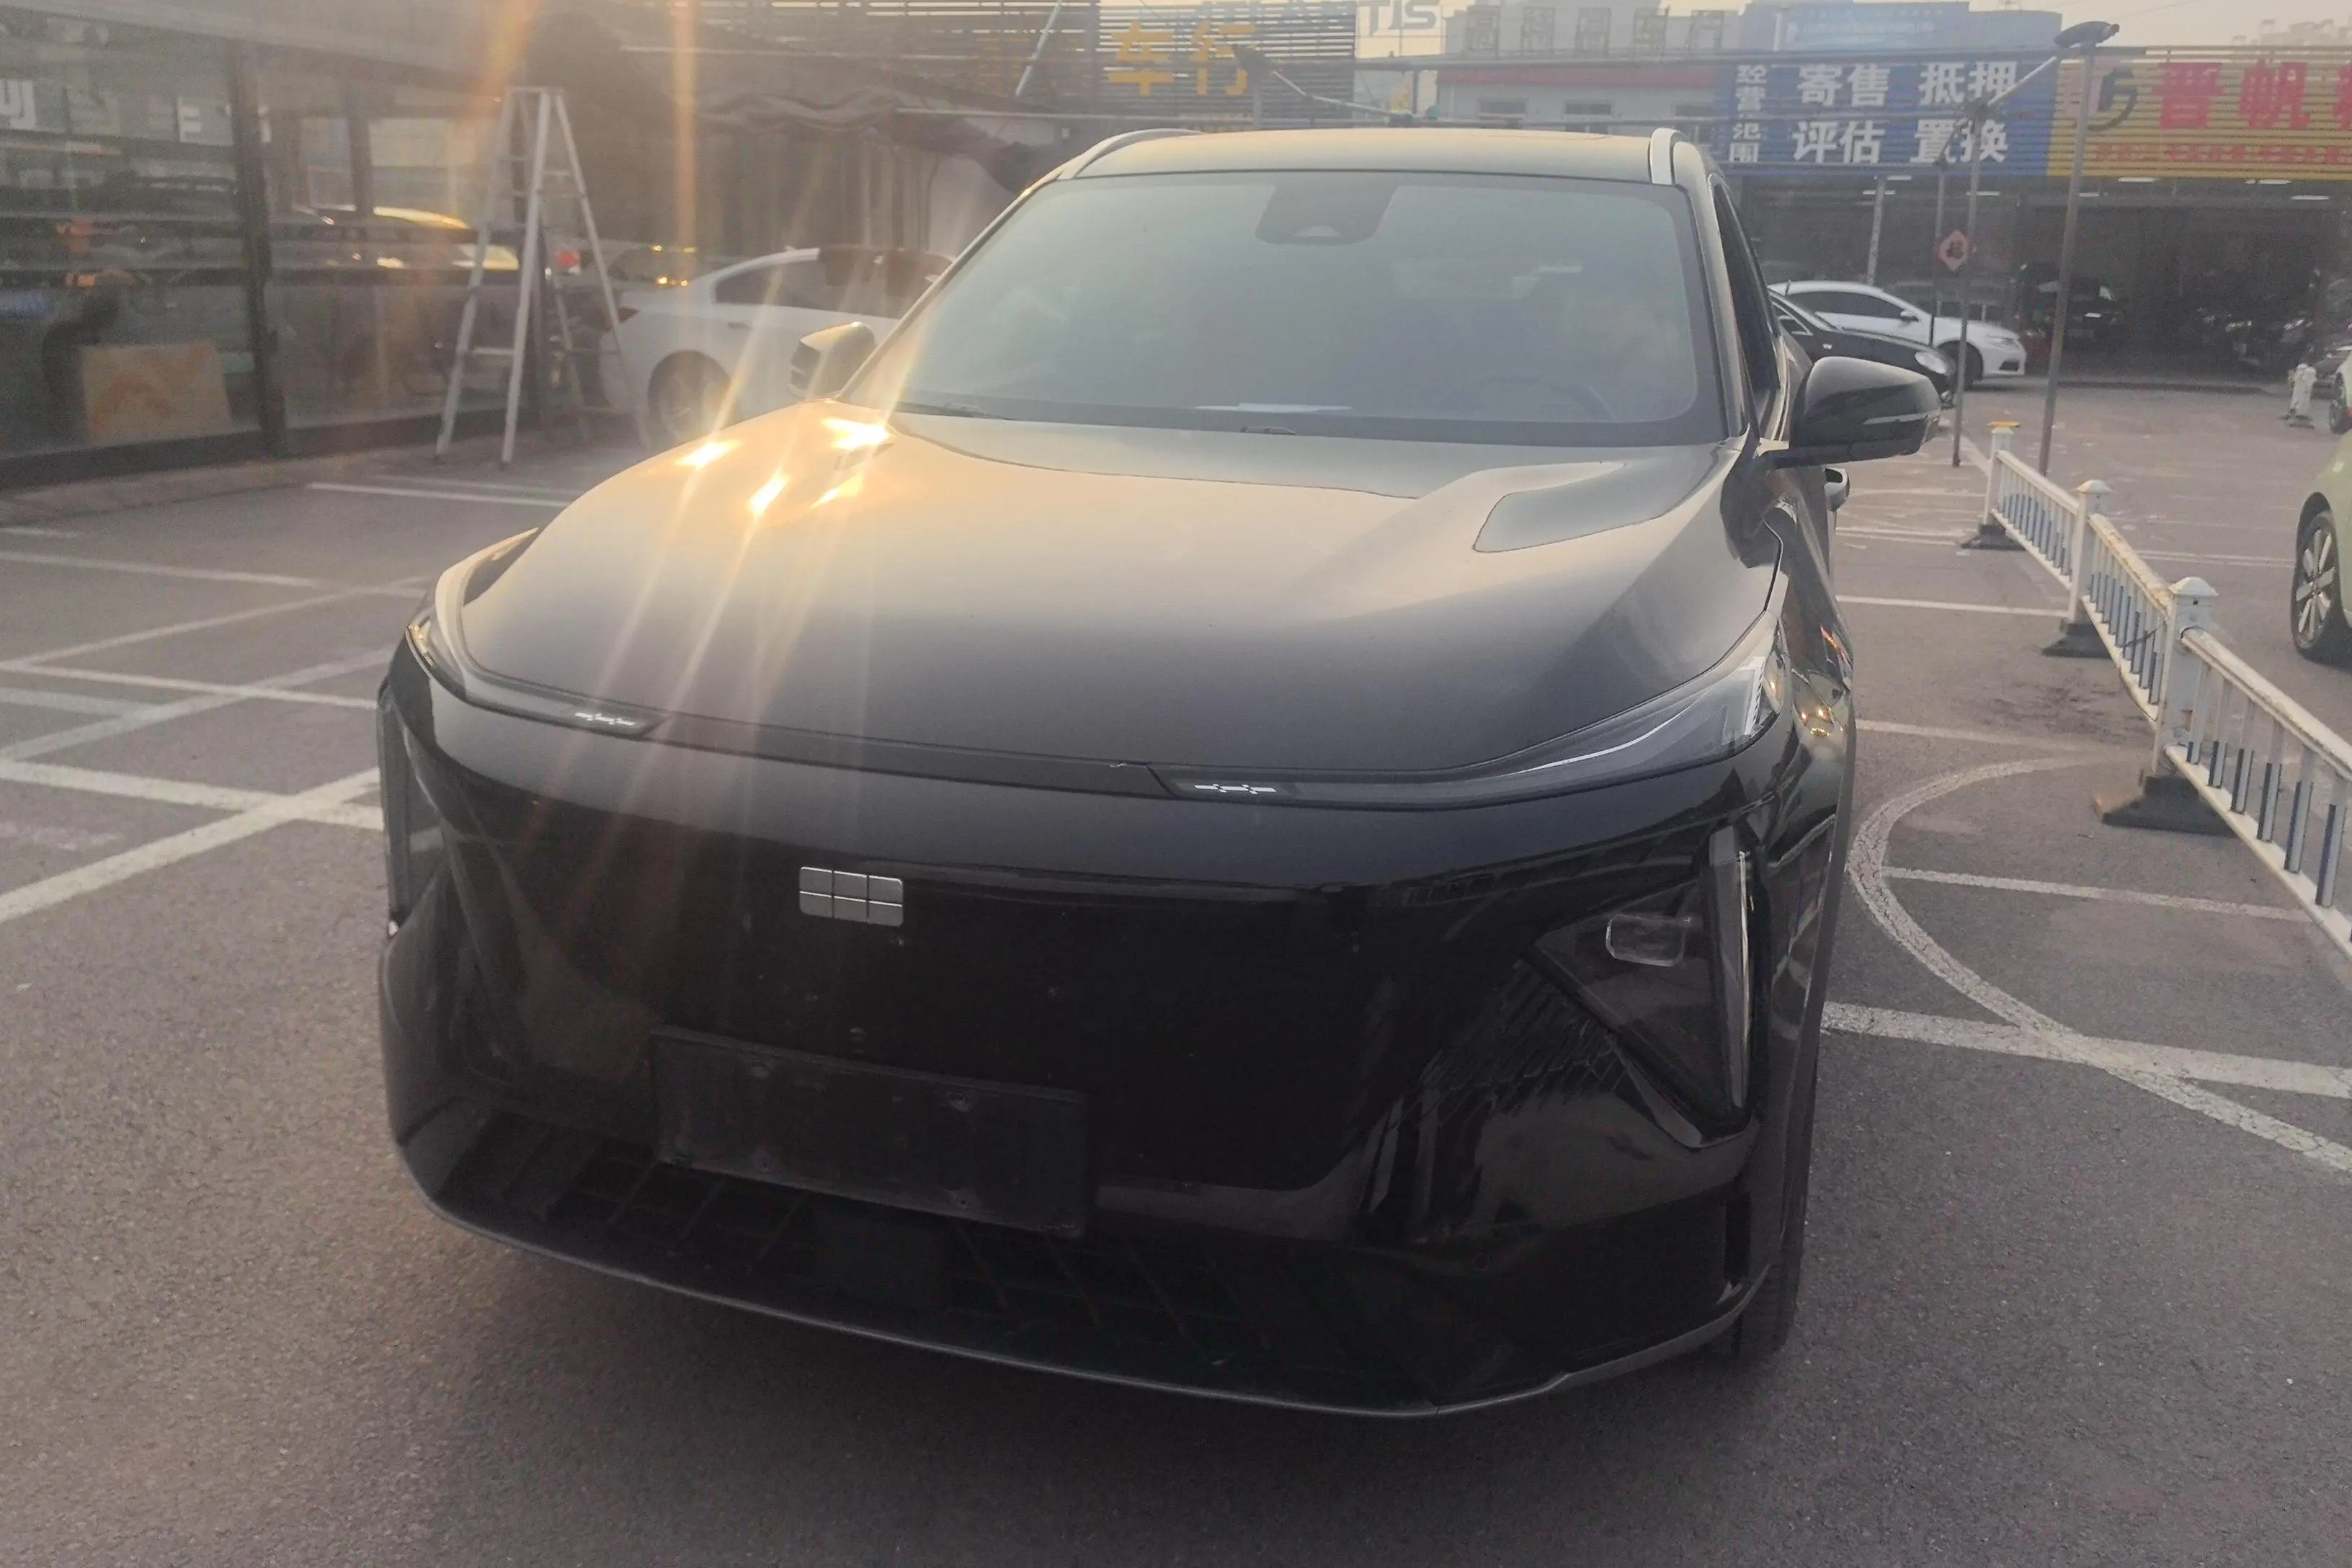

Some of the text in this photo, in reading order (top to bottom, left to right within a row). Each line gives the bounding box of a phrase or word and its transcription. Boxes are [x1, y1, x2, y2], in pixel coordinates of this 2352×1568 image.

[1796, 61, 2017, 107] 寄售 抵押
[2151, 56, 2352, 131] 晋帆
[1791, 117, 2010, 164] 评估 置换
